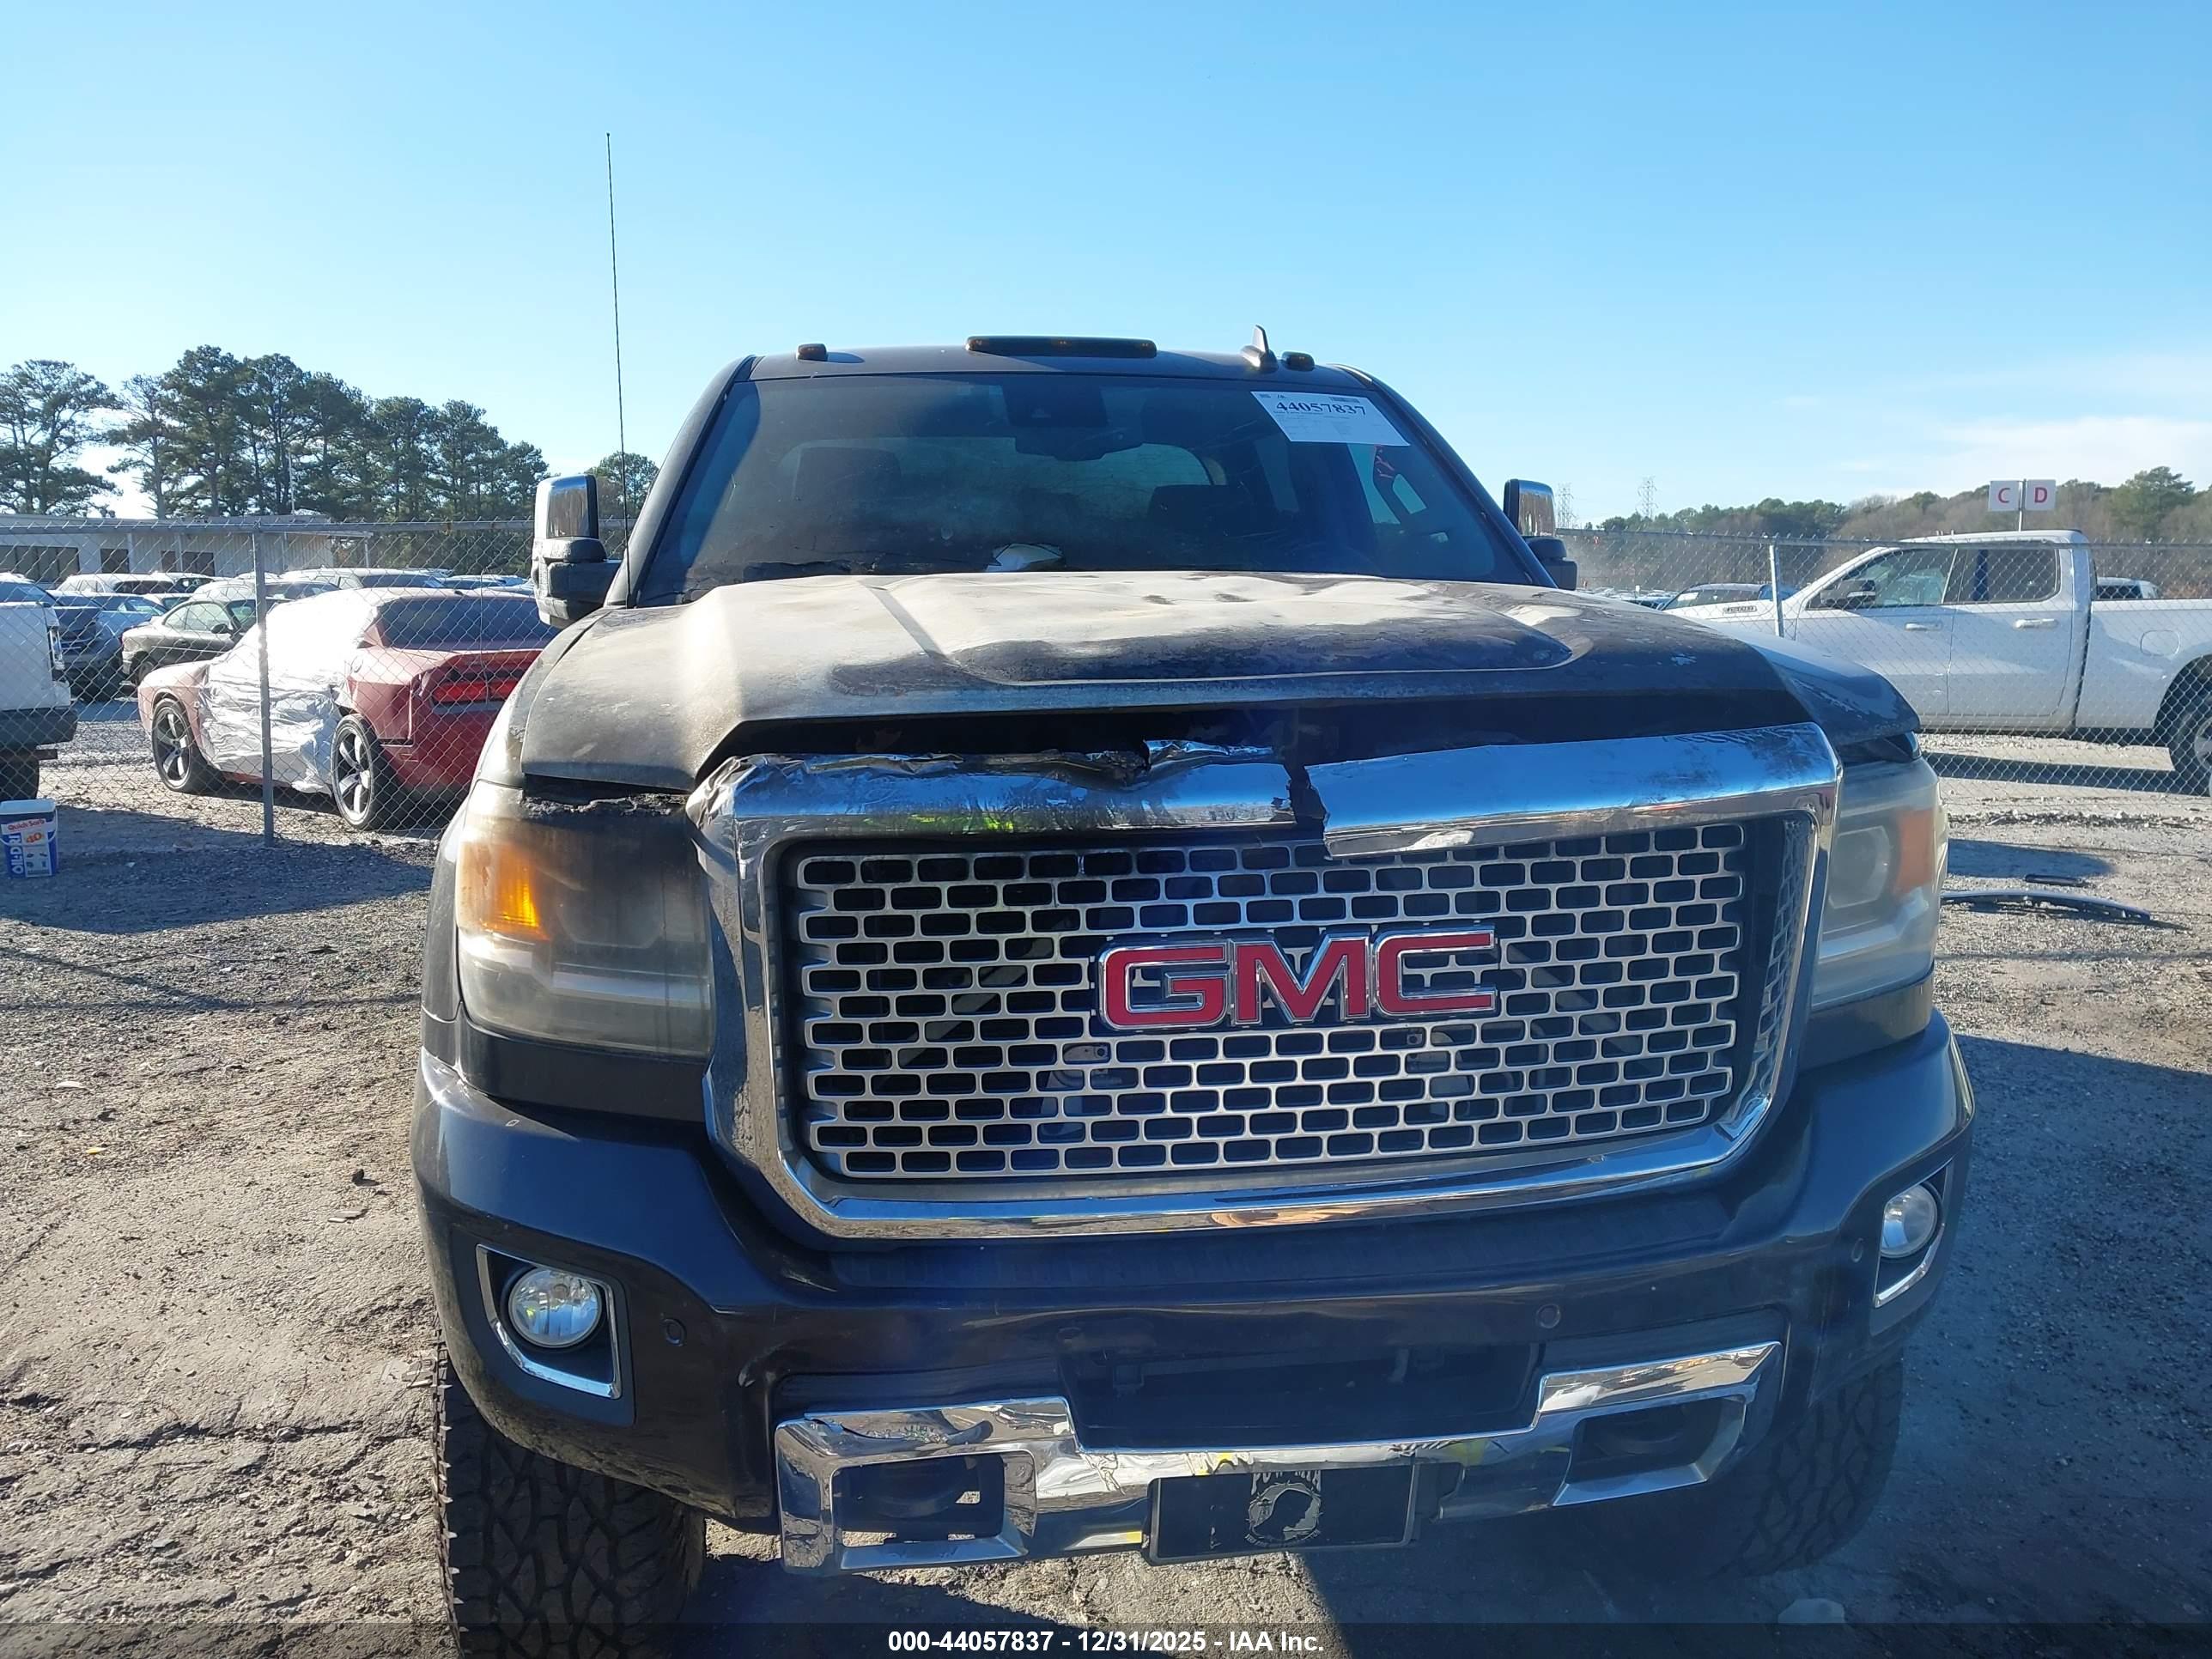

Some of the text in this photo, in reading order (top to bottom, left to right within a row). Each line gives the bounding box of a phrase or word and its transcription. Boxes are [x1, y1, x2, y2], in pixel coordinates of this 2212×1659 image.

[1276, 401, 1366, 416] 44057837
[1997, 487, 2011, 504] C
[2033, 487, 2048, 504] D
[1098, 930, 1498, 1030] GMC
